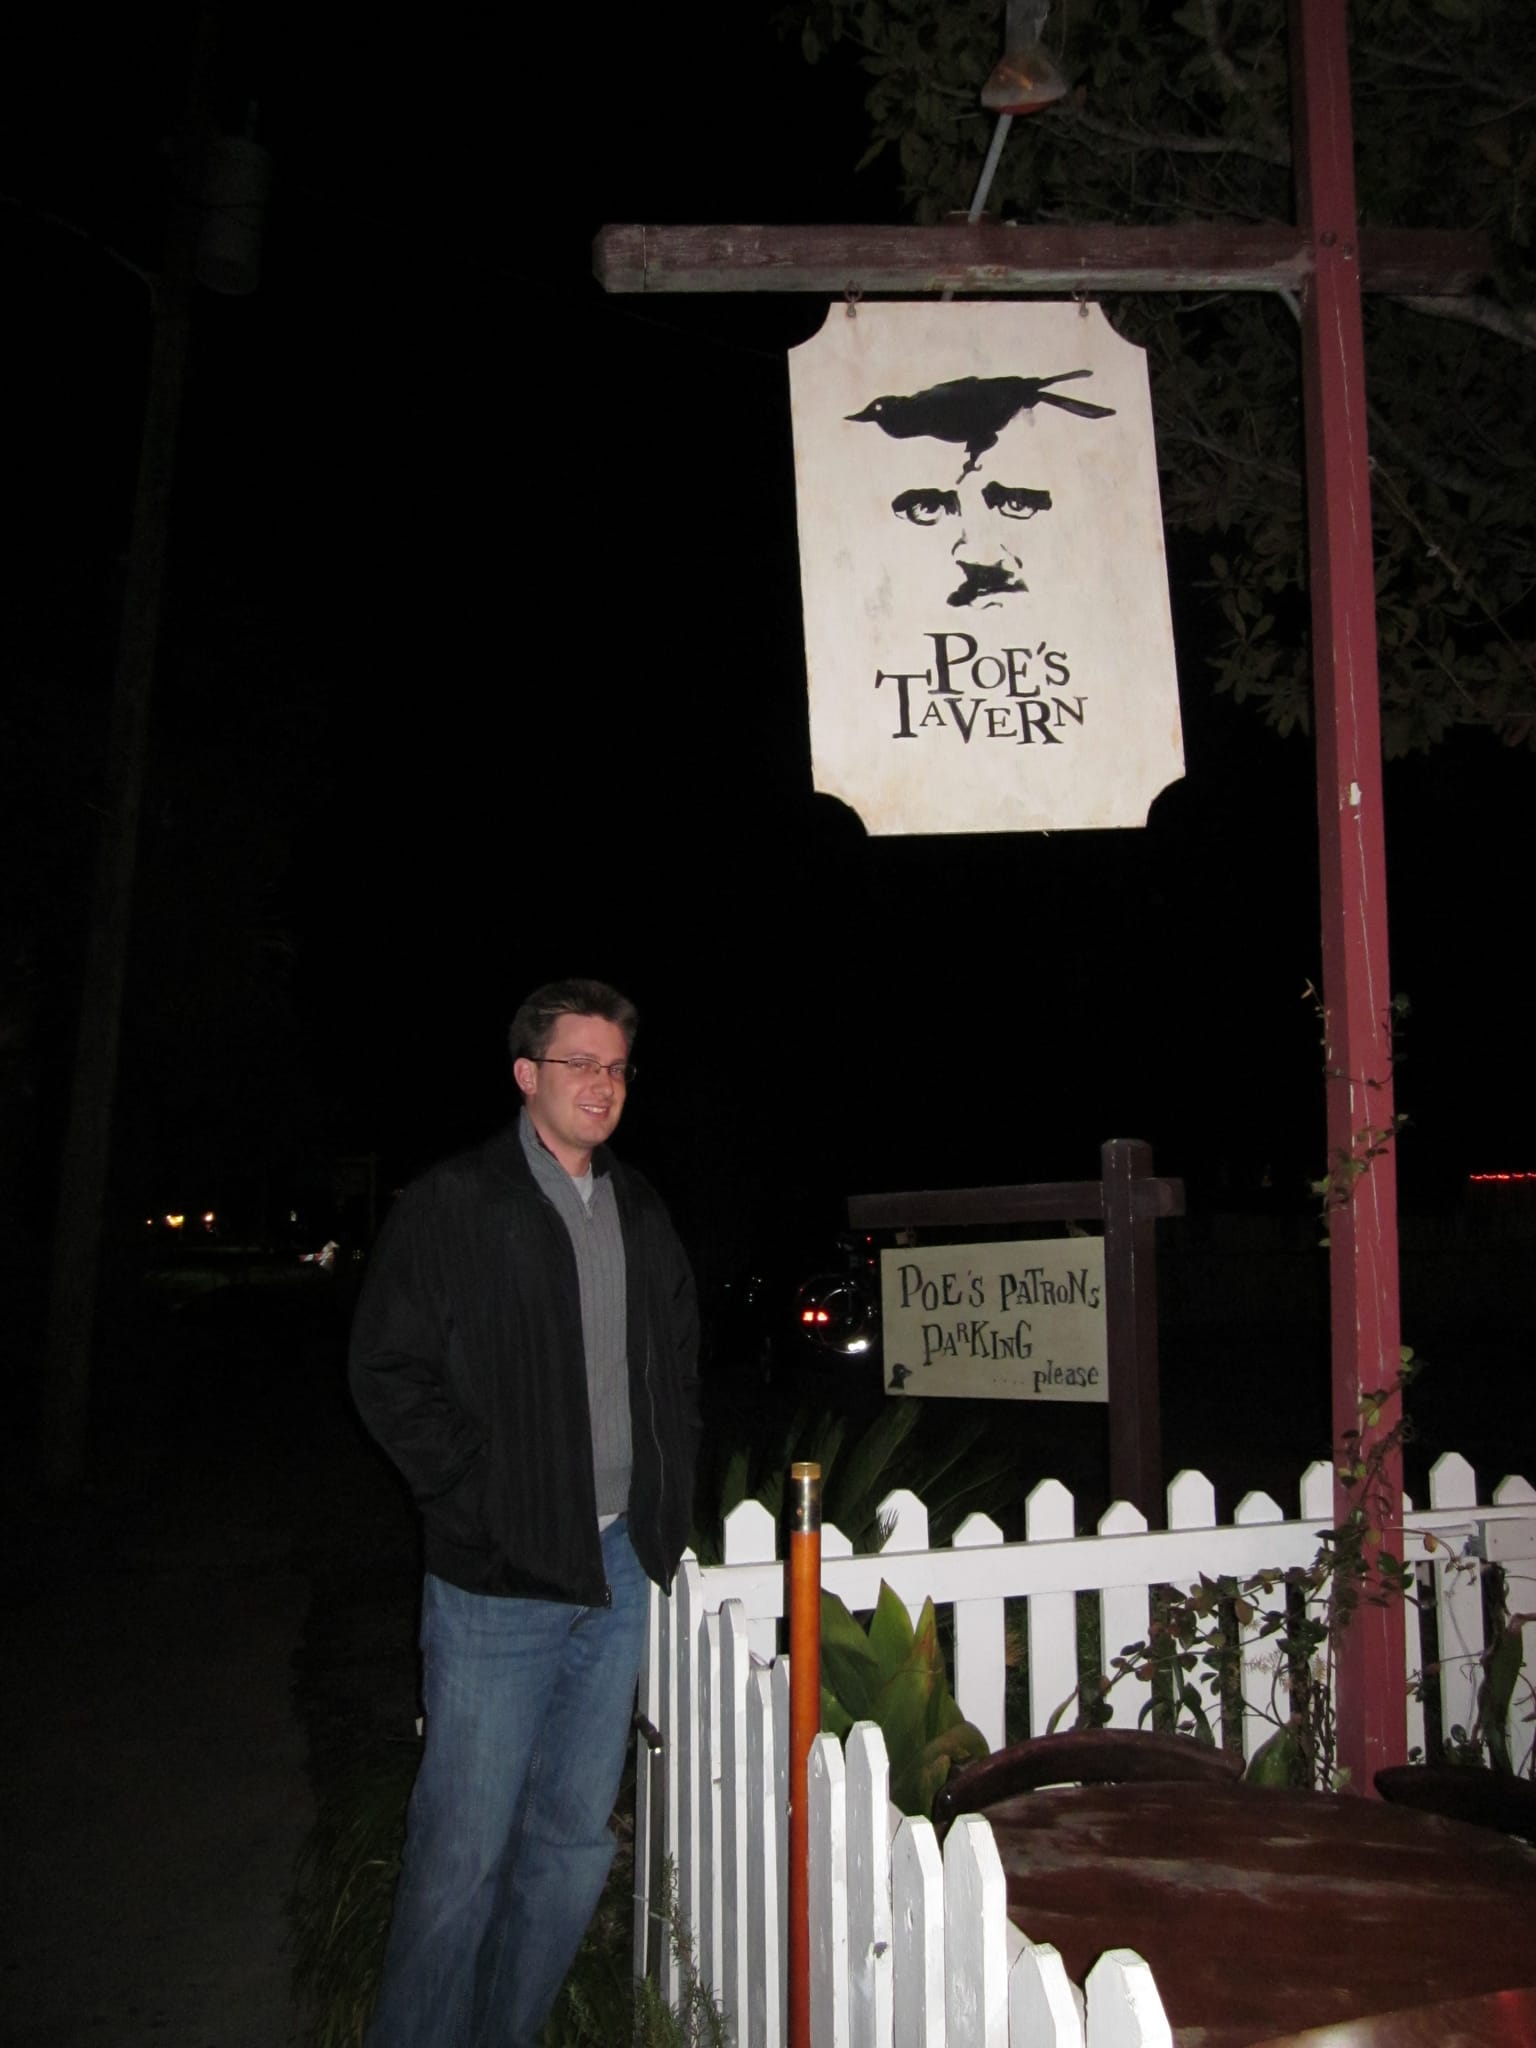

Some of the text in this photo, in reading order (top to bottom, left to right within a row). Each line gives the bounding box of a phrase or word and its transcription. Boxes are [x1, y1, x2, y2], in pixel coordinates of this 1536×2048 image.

[923, 632, 1070, 698] POE'S
[874, 668, 1088, 745] TAVERN
[897, 1264, 985, 1311] POE'S
[921, 1320, 1033, 1367] PARKING
